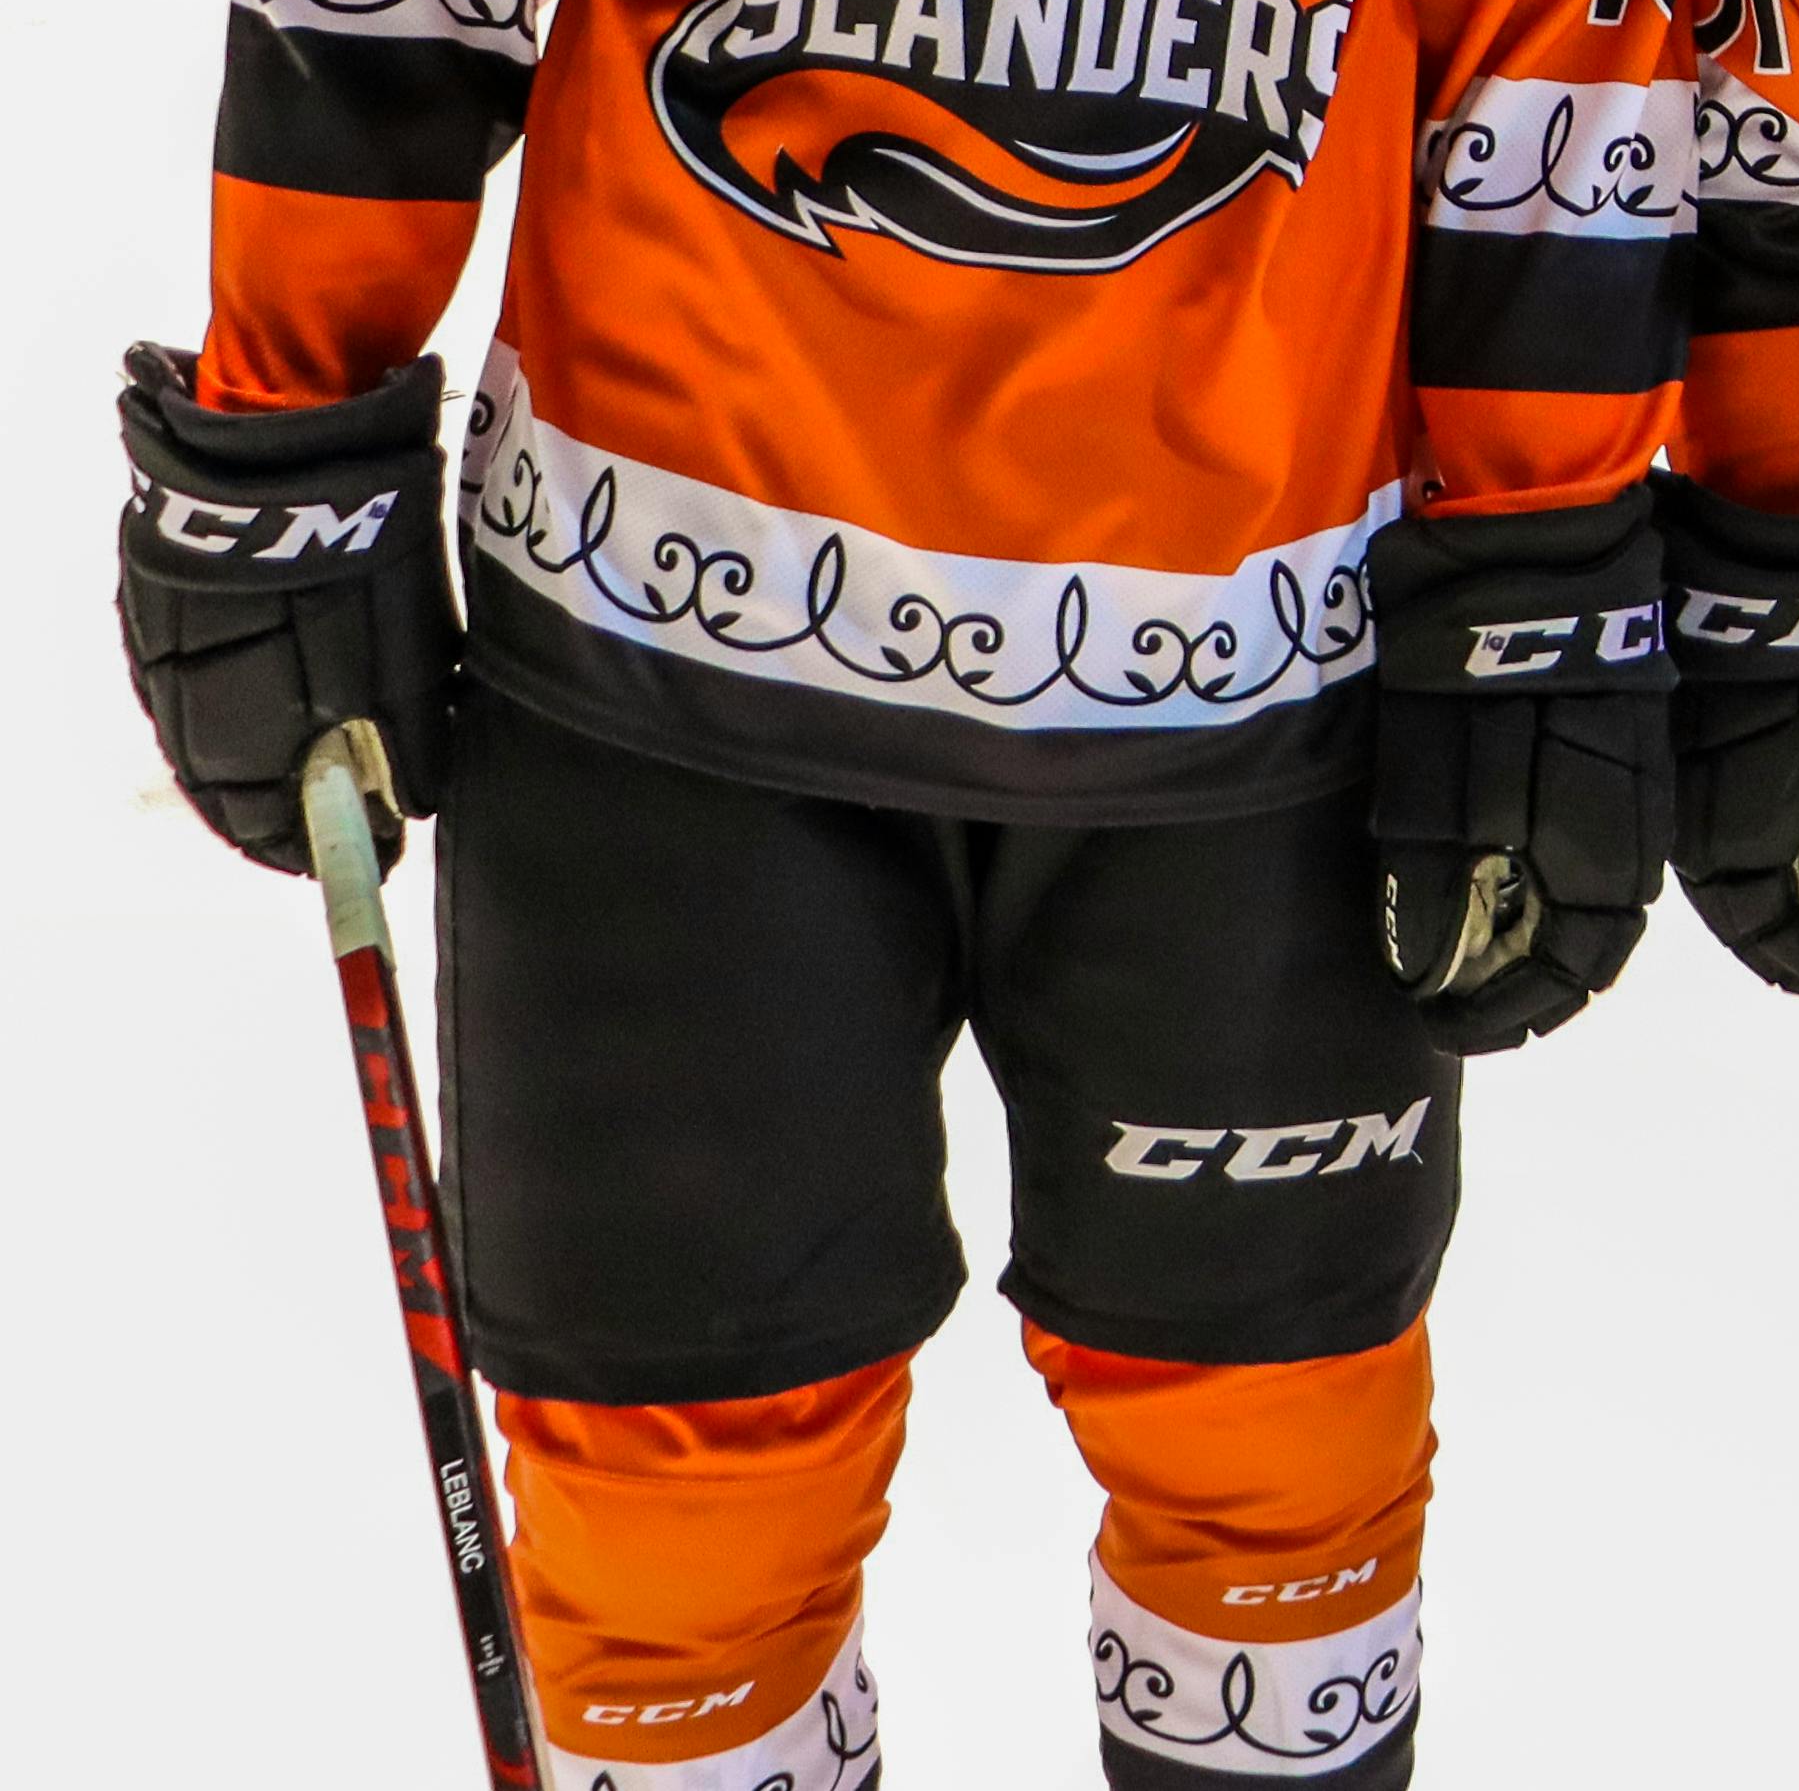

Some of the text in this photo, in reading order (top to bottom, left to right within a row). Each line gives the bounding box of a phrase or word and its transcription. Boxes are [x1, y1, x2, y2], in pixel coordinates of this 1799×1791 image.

[1465, 599, 1664, 678] CC
[1105, 1097, 1431, 1182] CCM
[440, 1459, 485, 1573] LEBLANC
[1221, 1557, 1378, 1606] CCM
[582, 1680, 756, 1725] CCM
